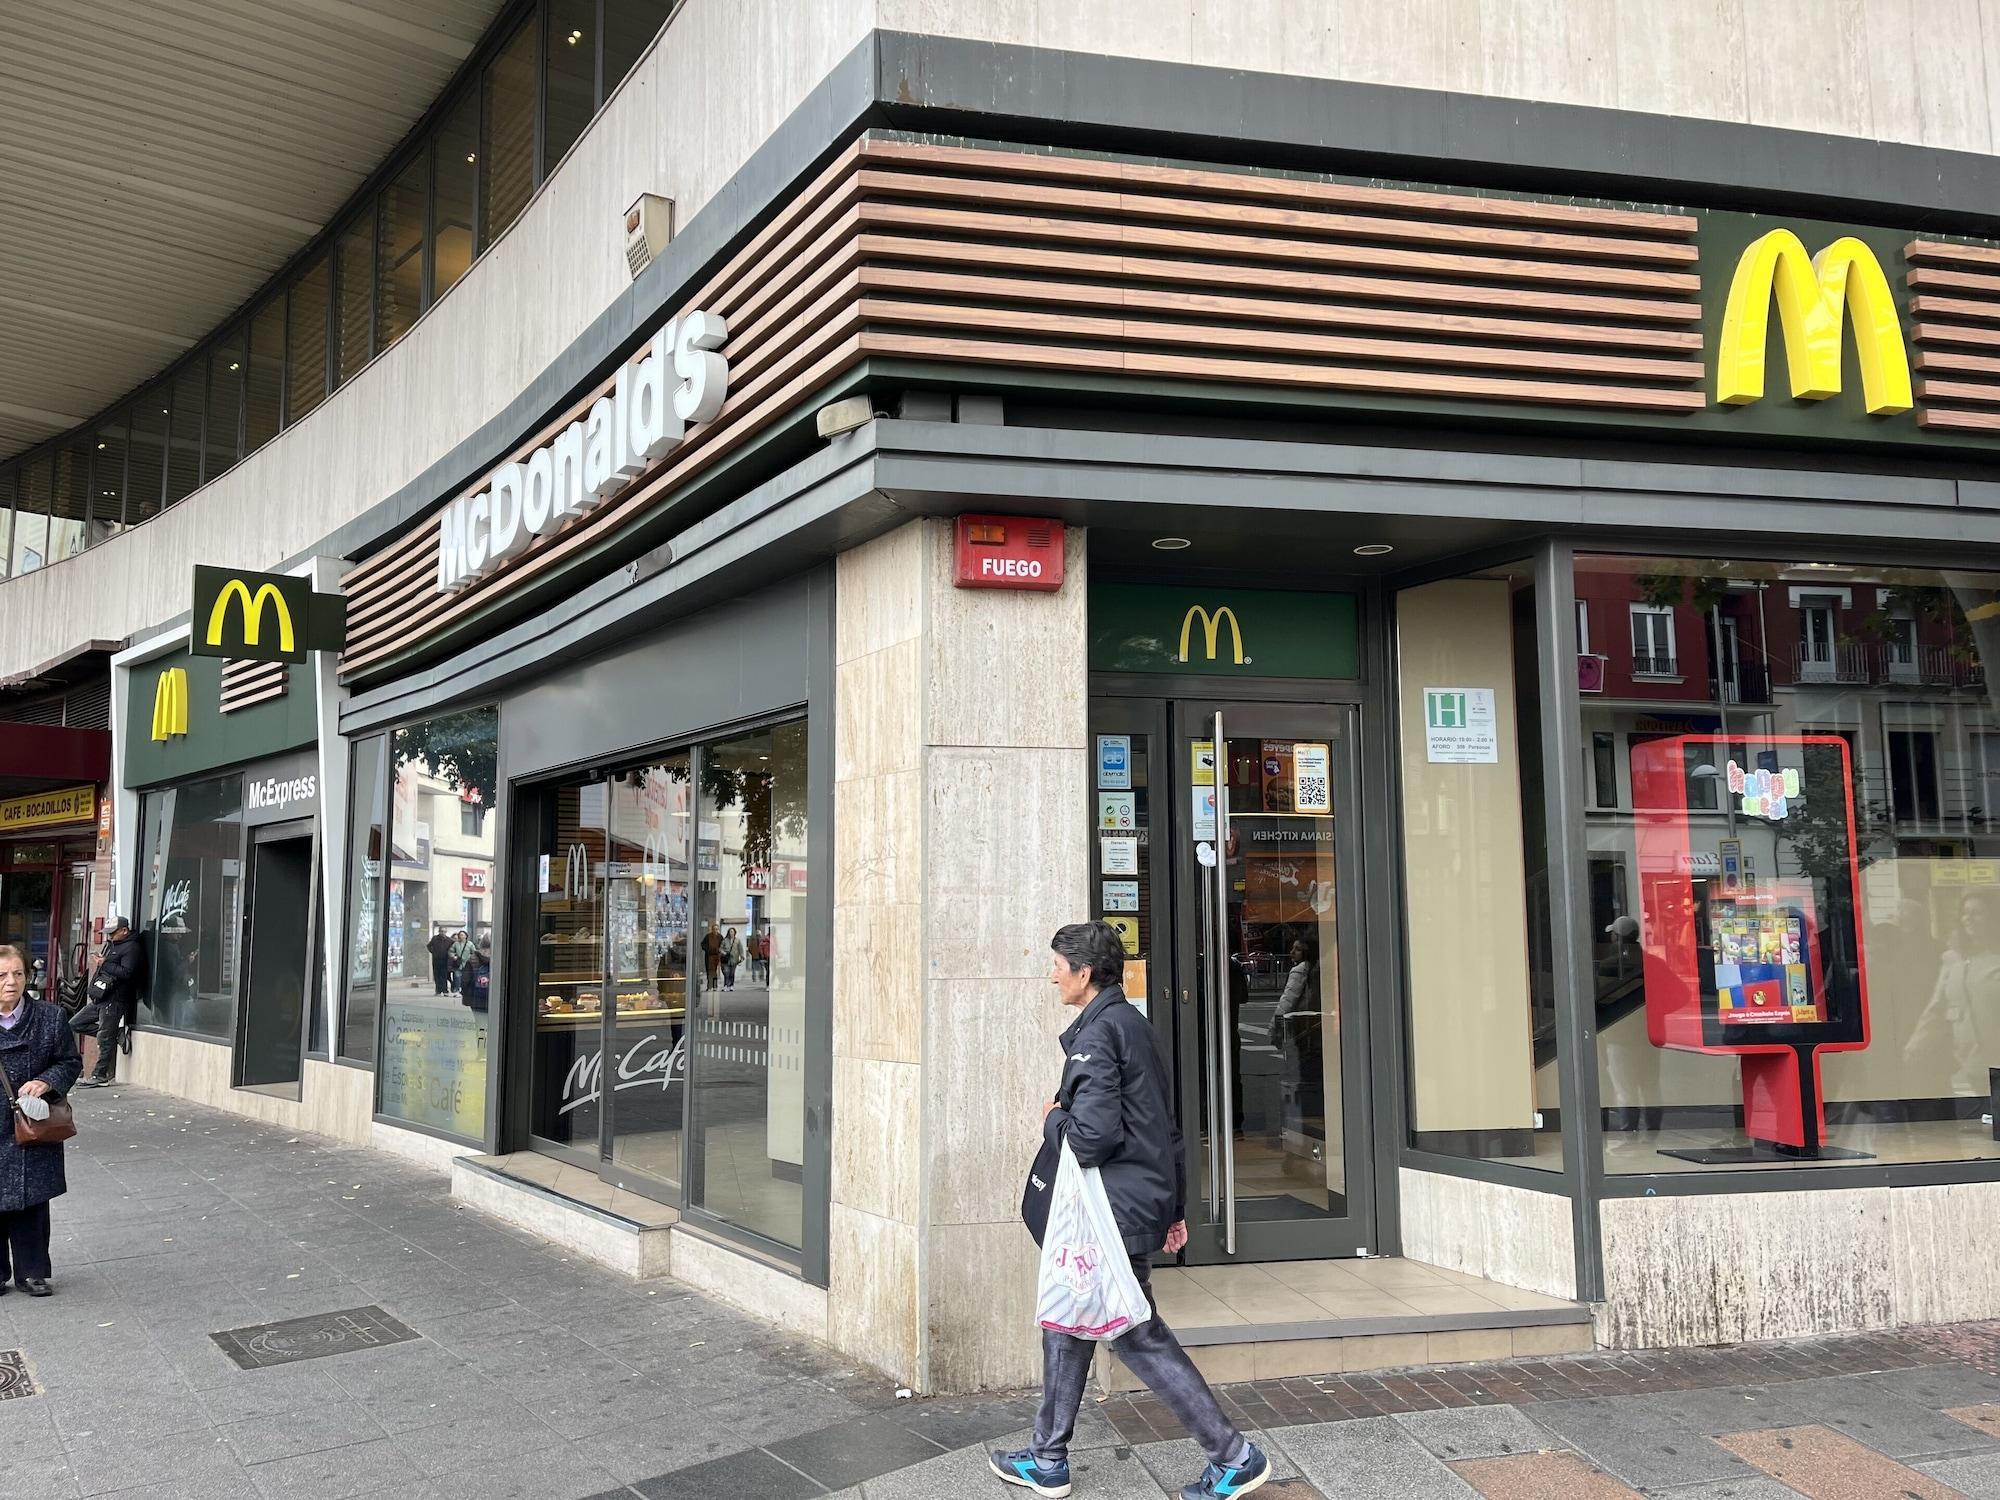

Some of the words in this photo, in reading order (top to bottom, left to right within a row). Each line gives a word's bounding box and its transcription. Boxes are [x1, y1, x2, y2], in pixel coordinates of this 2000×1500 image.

[437, 310, 729, 594] McDonald's
[981, 558, 1042, 578] FUEGO
[4, 805, 21, 821] CAFE
[26, 798, 72, 818] BOCADILLOS
[248, 774, 316, 810] McExpress
[430, 1077, 463, 1114] Café
